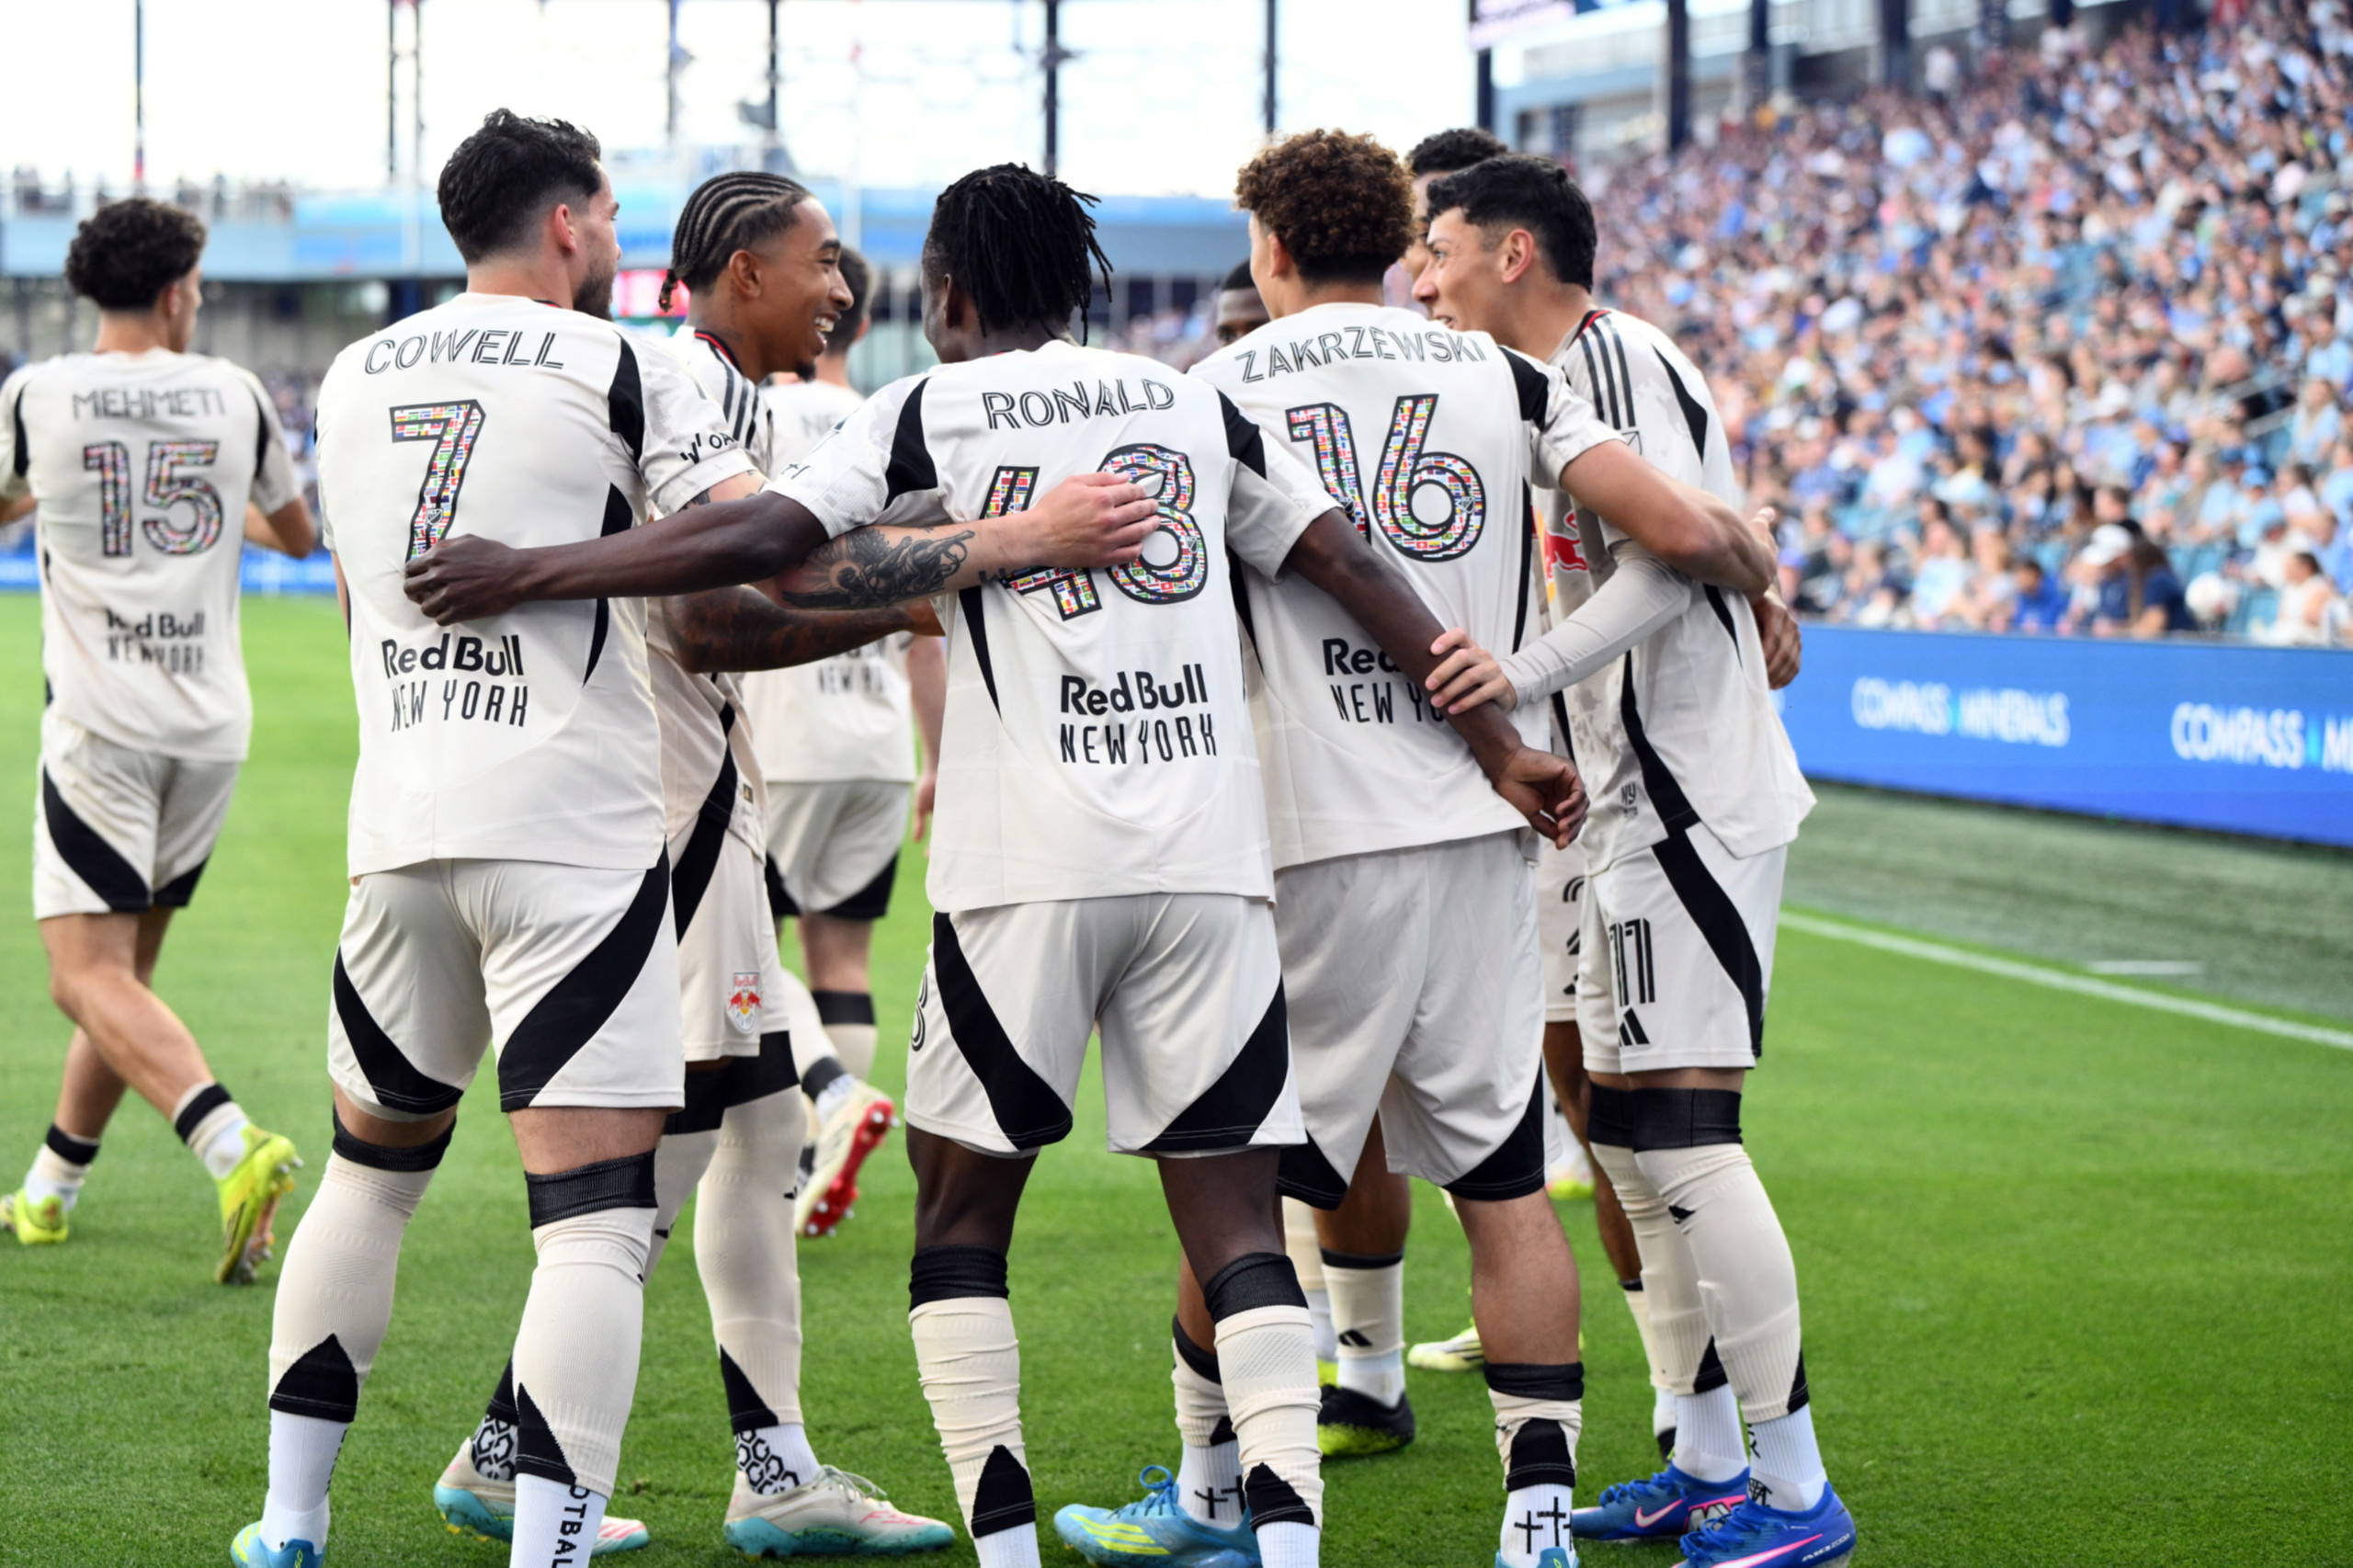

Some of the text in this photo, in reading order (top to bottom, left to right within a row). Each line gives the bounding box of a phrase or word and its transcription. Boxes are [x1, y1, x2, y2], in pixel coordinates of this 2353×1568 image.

[363, 328, 565, 375] COWELL
[1234, 325, 1487, 383] ZAKRZEWSKI
[72, 387, 226, 421] MEHMETI
[981, 377, 1176, 430] RONALD
[83, 439, 224, 559] 15
[389, 399, 486, 563] 7
[1285, 392, 1486, 562] 16
[381, 632, 525, 680] Red Bull
[391, 678, 529, 733] NEW YORK
[1060, 663, 1209, 717] Red Bull
[1330, 681, 1394, 724] NEW
[1060, 712, 1218, 766] NEW YORK
[2170, 701, 2305, 770] COMPASS
